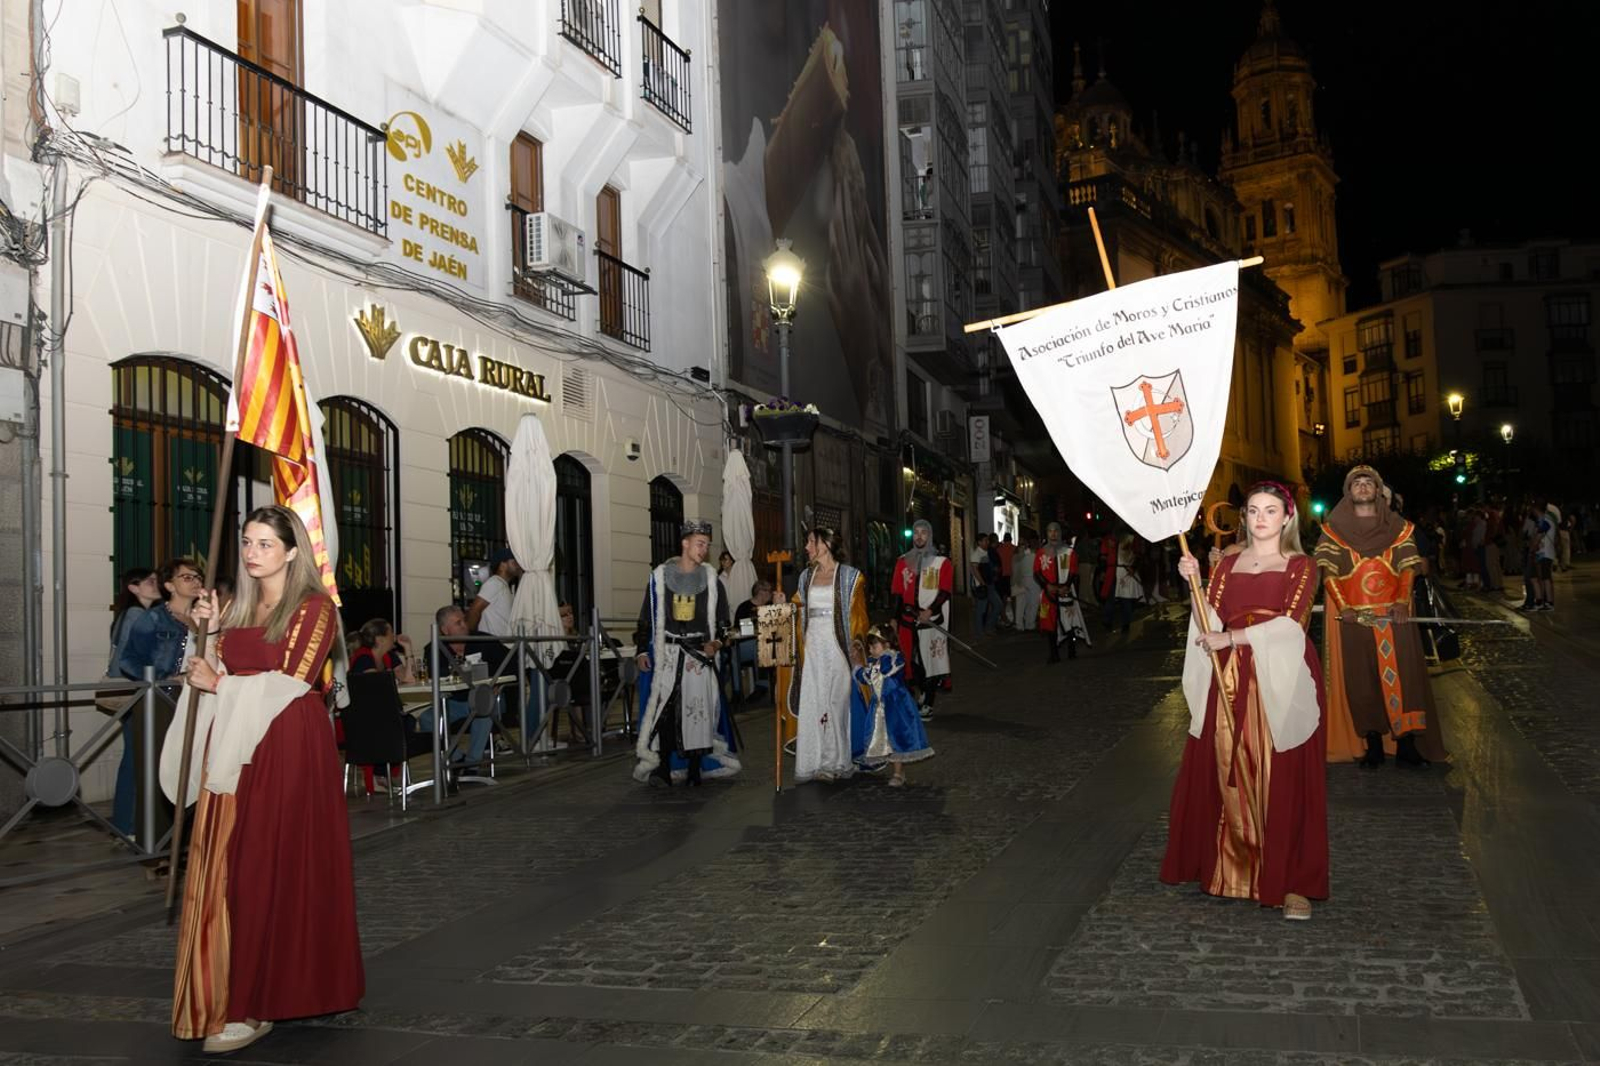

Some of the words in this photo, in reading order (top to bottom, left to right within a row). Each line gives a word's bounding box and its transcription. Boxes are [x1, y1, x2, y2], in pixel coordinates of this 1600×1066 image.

[403, 173, 468, 217] CENTRO
[390, 200, 413, 225] DE
[419, 213, 479, 255] PRENSA
[402, 239, 423, 262] DE
[428, 251, 467, 280] JAÉN
[1018, 325, 1092, 361] Asociación
[1095, 319, 1112, 332] de
[1112, 309, 1158, 326] Moros
[1161, 304, 1169, 318] y
[1117, 333, 1136, 349] del
[1136, 330, 1166, 345] Ave
[409, 336, 475, 380] CAJA
[478, 356, 552, 403] RURAL
